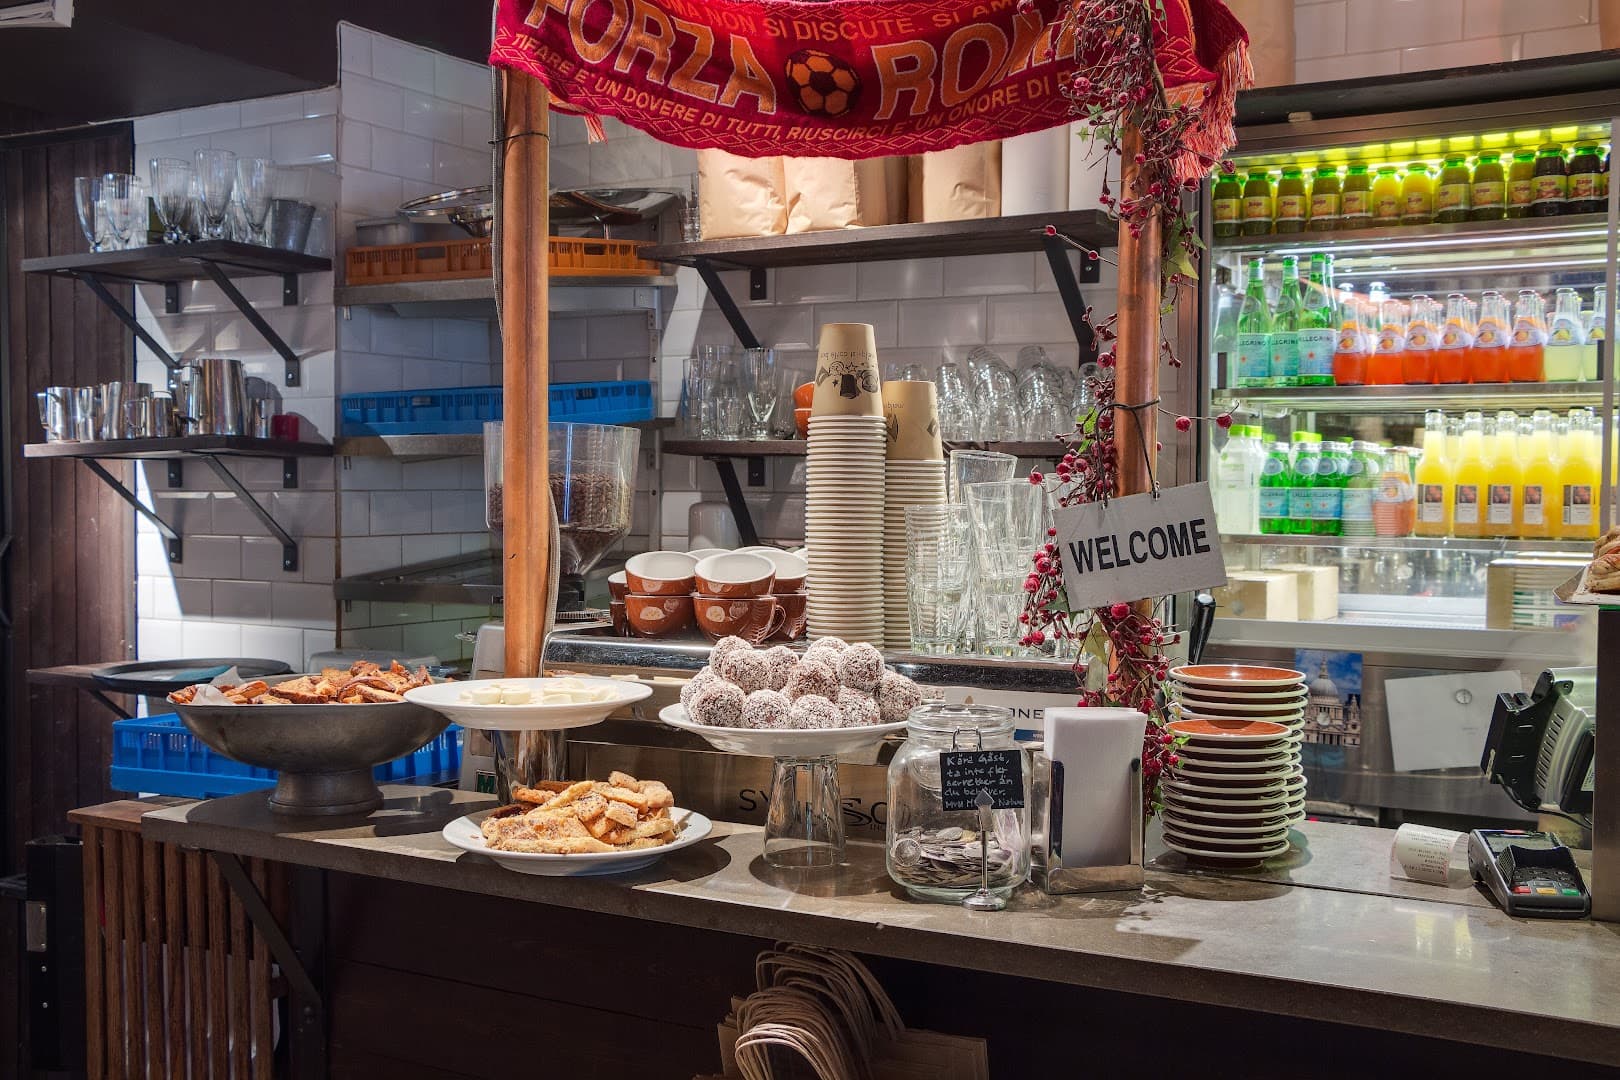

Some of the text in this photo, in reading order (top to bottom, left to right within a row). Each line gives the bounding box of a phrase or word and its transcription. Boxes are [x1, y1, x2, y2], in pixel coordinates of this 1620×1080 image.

[705, 7, 757, 34] NON
[764, 18, 787, 39] SI
[932, 11, 960, 28] SI
[511, 33, 575, 75] TIFARE
[595, 76, 621, 98] UN
[623, 86, 699, 122] DOVERE
[700, 112, 722, 128] DI
[727, 117, 781, 141] TUTTI,
[916, 113, 944, 131] UN
[948, 83, 1020, 122] ONORE
[1026, 76, 1050, 100] DI
[870, 0, 1080, 120] ROM
[1069, 518, 1211, 574] WELCOME
[964, 767, 985, 776] inte
